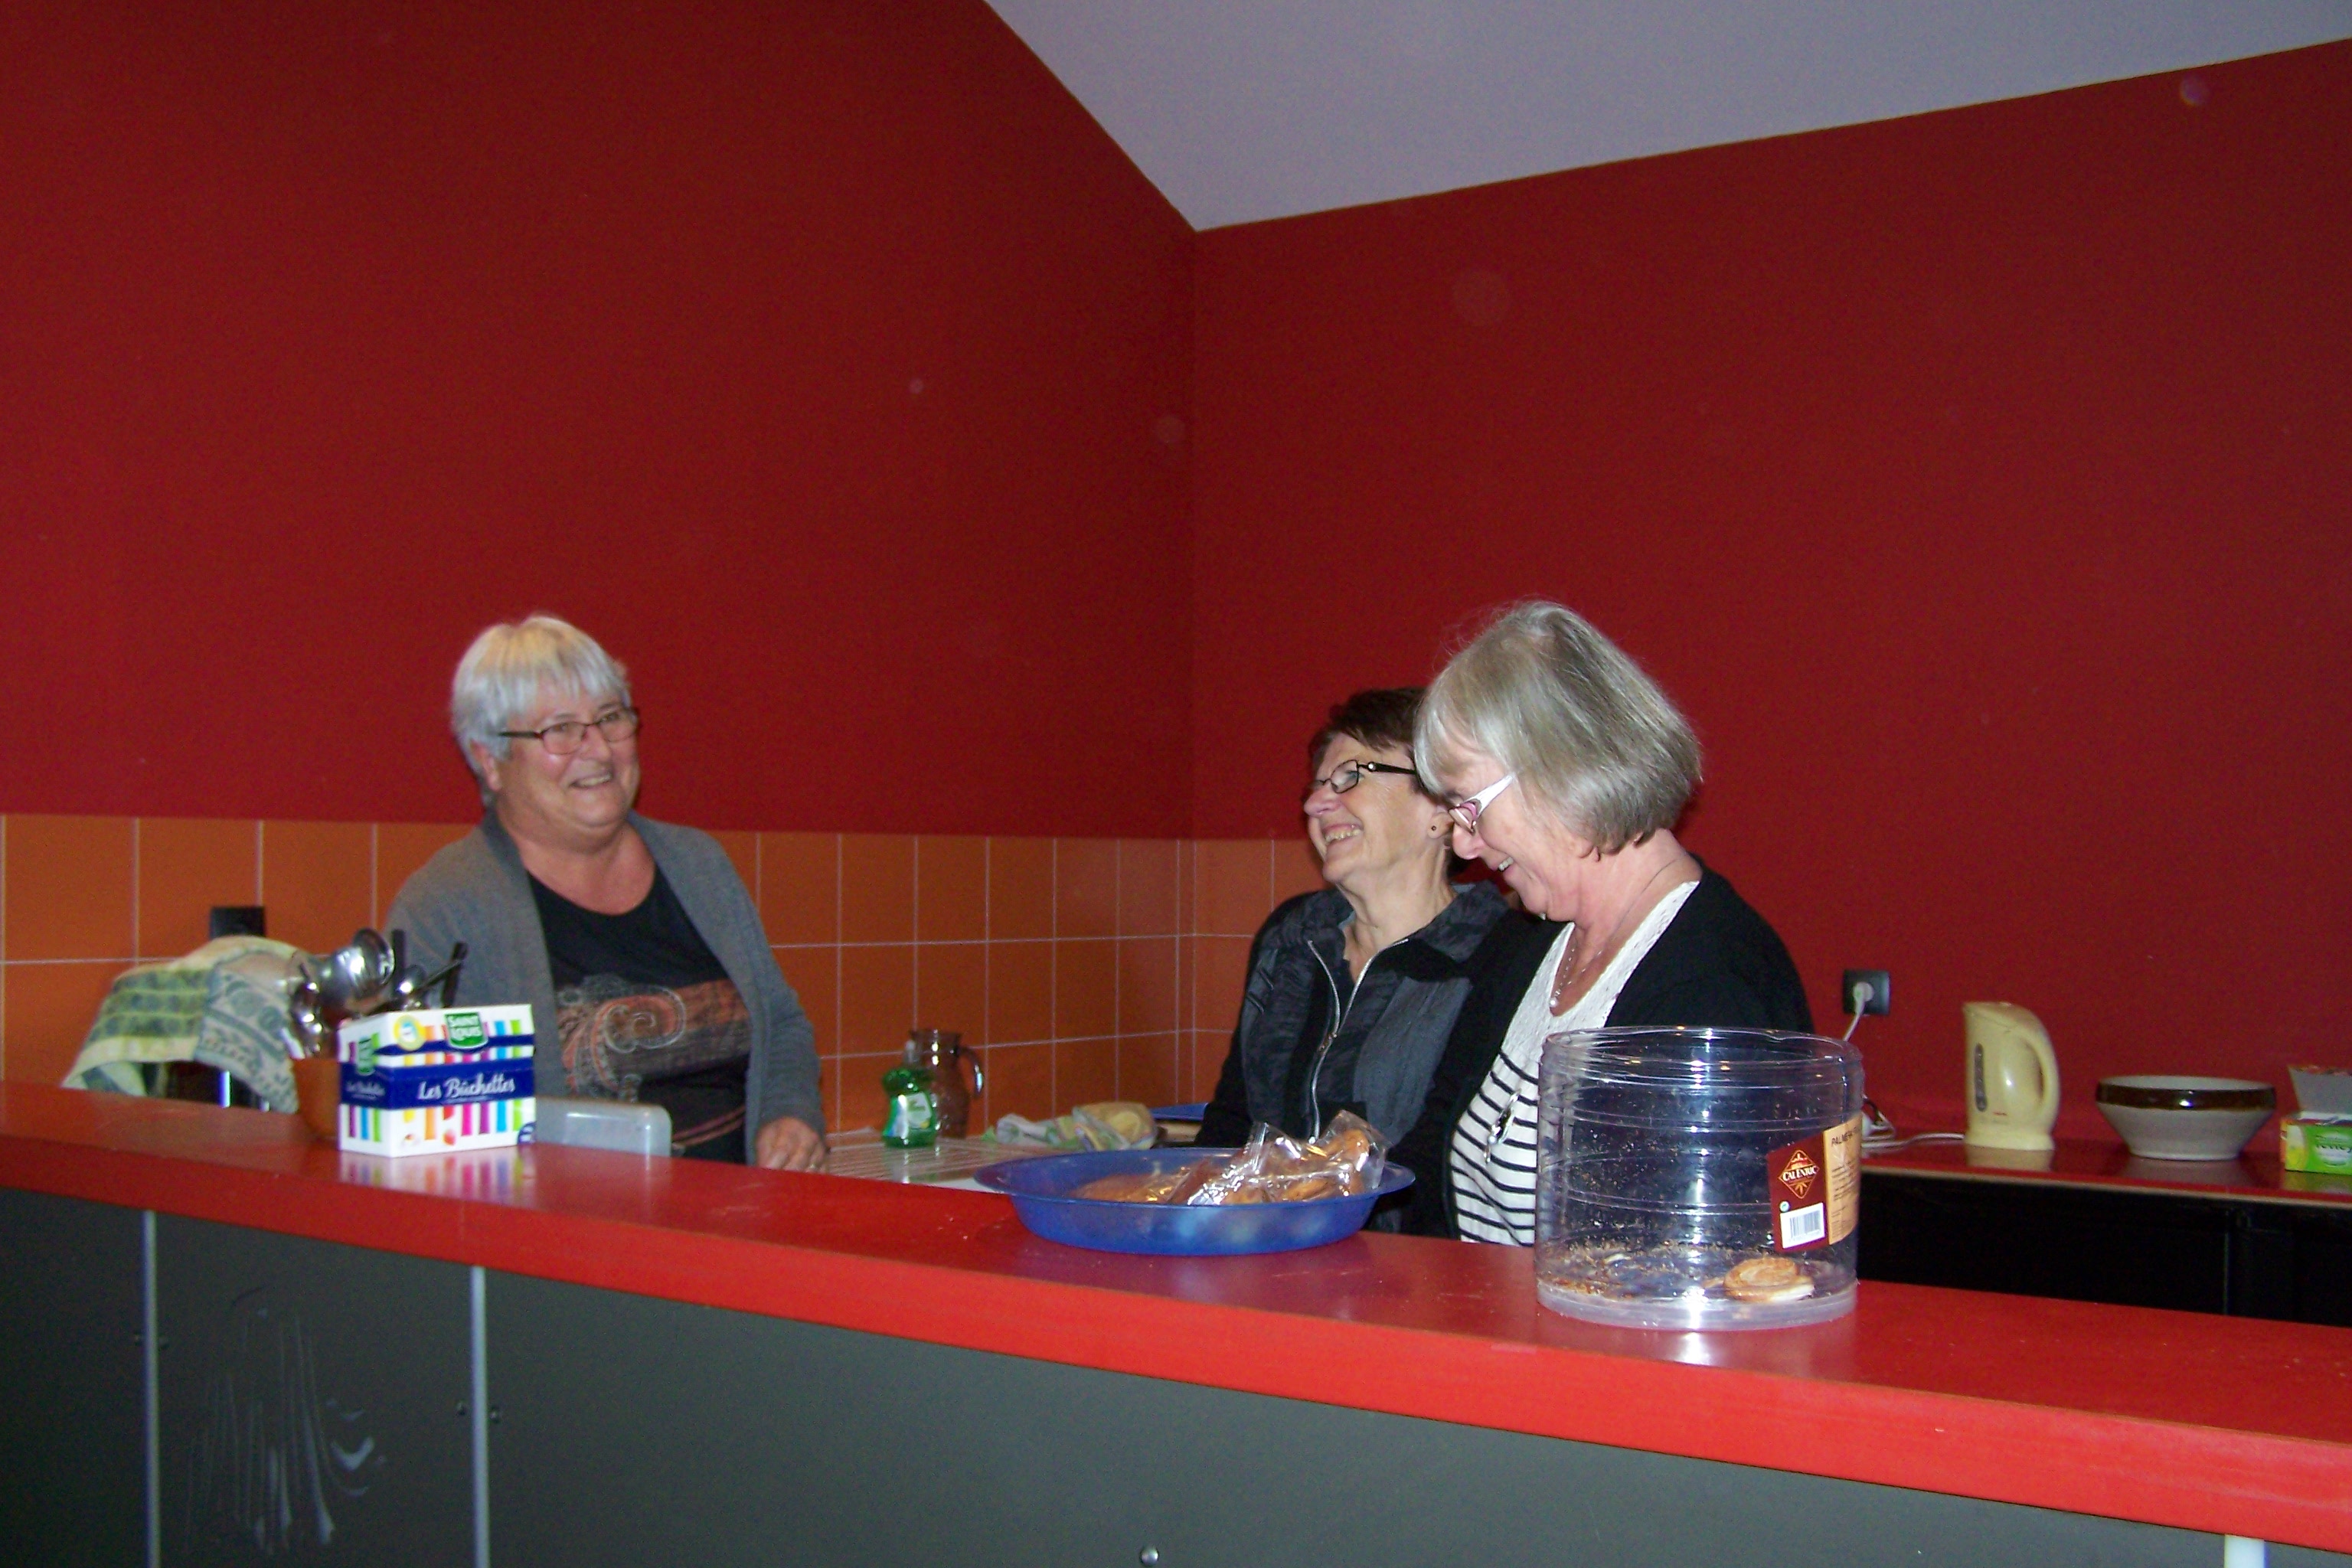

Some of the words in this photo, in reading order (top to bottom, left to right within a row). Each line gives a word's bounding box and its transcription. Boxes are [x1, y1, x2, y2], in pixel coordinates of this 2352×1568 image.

[448, 1015, 479, 1027] SAINT
[417, 1081, 442, 1099] Les
[443, 1073, 515, 1098] Bûchettes
